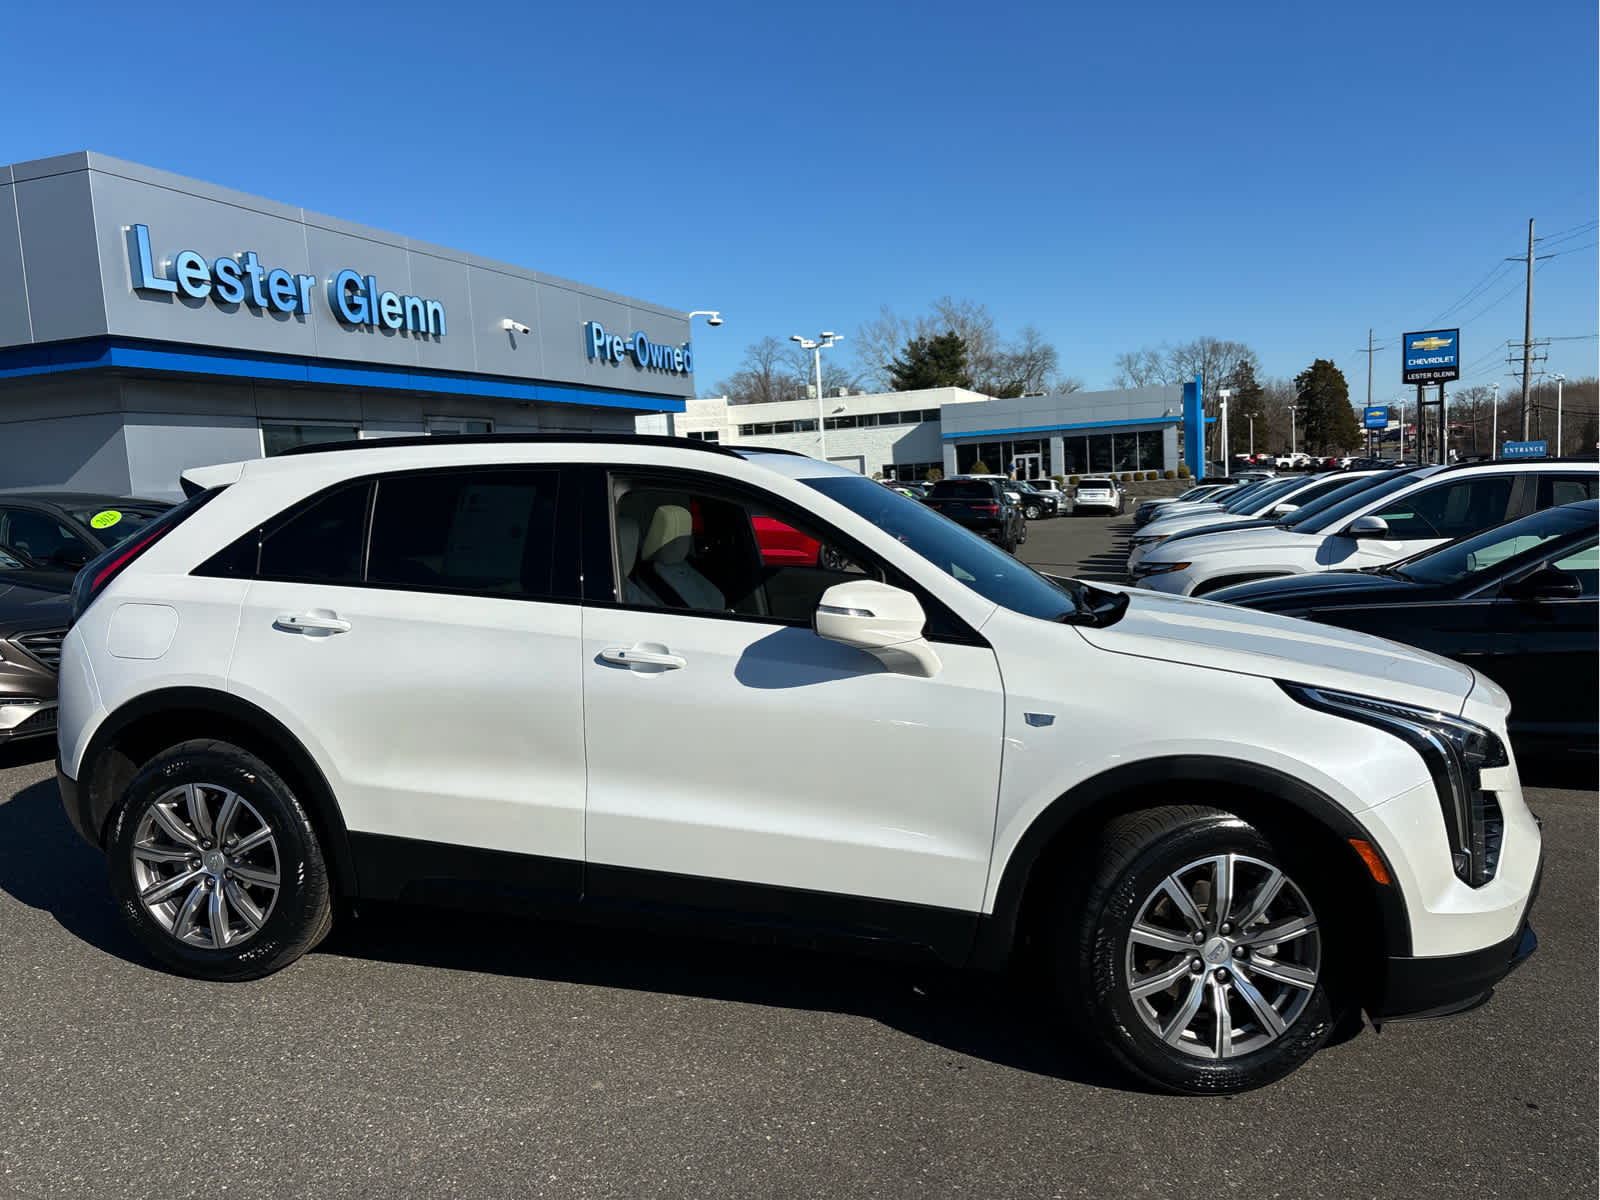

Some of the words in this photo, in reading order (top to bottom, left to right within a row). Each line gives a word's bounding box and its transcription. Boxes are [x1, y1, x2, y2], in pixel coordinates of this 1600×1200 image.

[126, 223, 315, 314] Lester
[329, 269, 446, 336] Glenn
[585, 321, 694, 373] Pre-Owned
[1408, 355, 1455, 366] CHEVROLET
[1407, 372, 1432, 380] LESTER
[1433, 370, 1456, 378] GLENN
[1504, 445, 1545, 454] ENTRANCE
